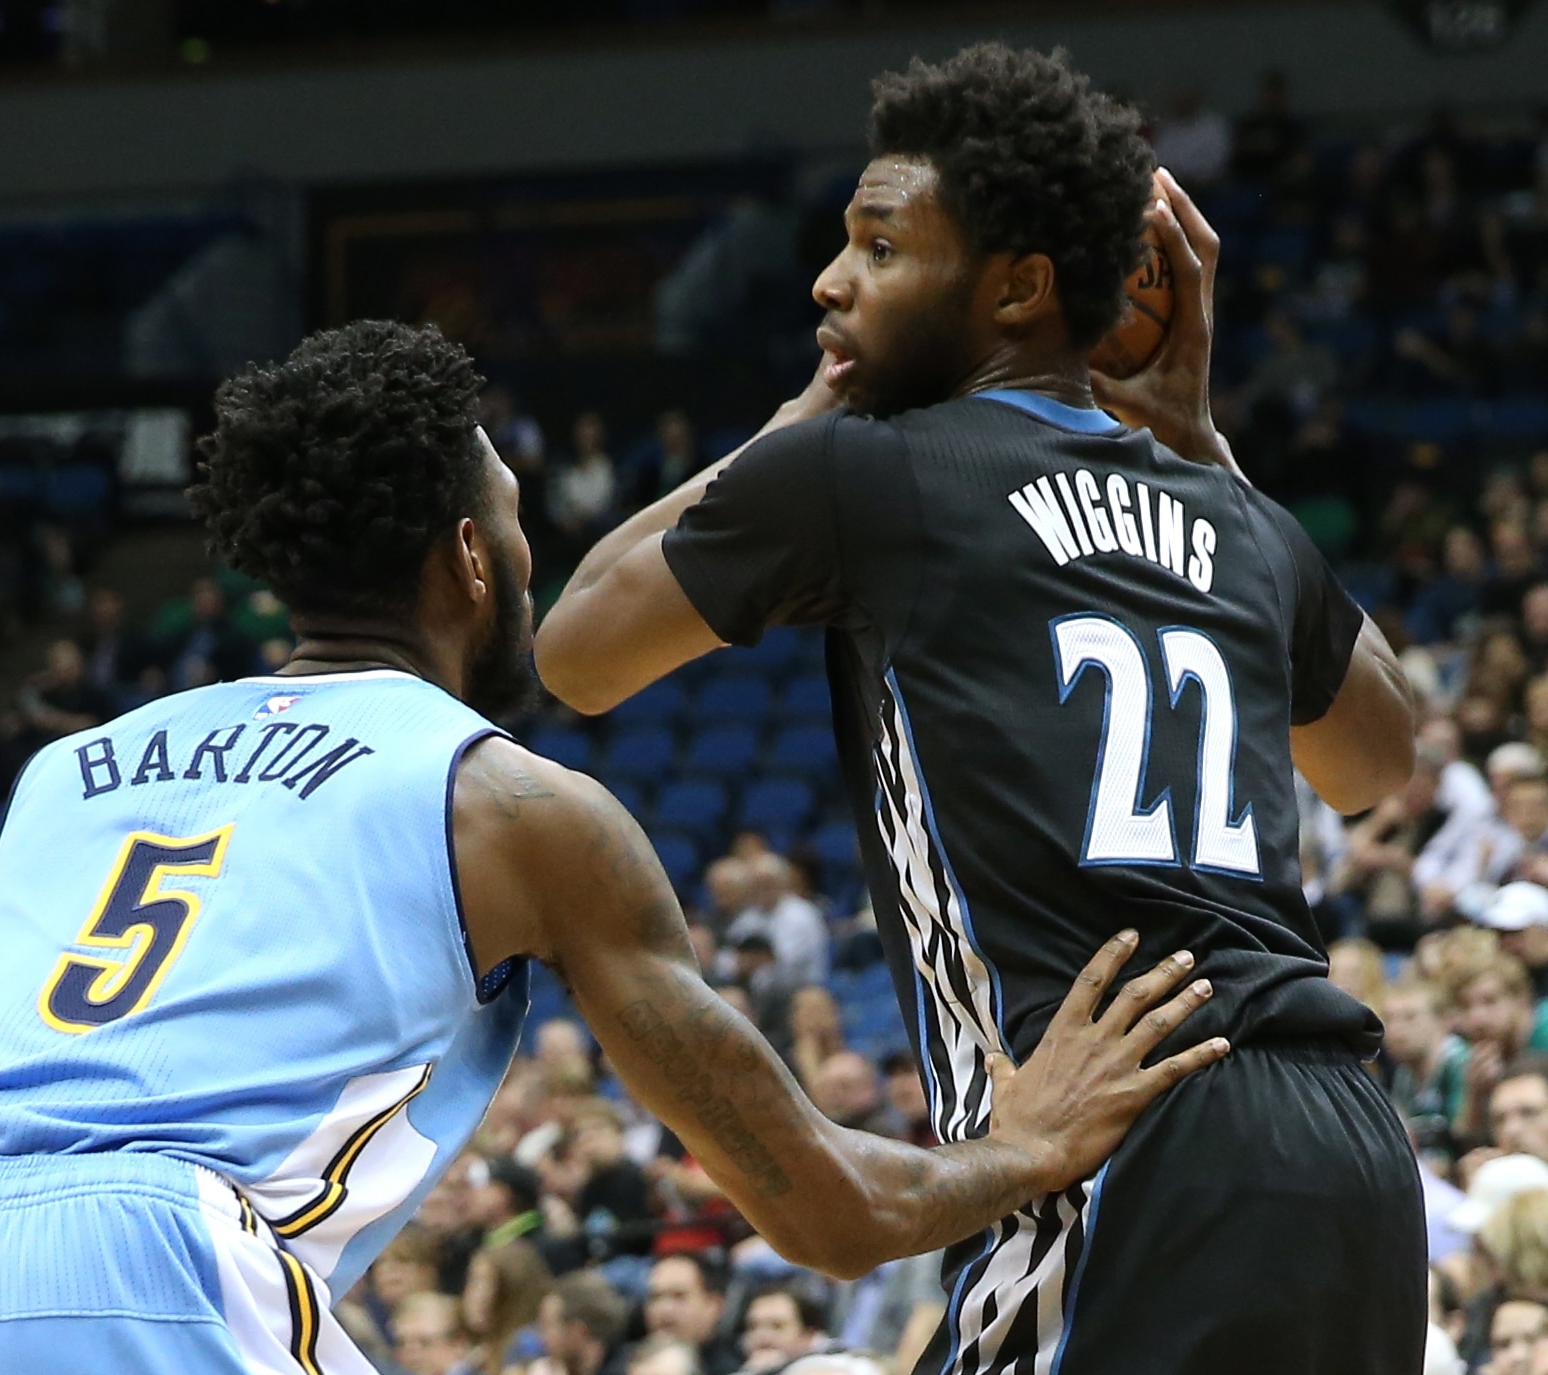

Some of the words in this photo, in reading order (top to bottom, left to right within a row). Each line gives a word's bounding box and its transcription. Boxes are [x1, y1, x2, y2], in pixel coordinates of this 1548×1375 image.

[1008, 469, 1217, 594] WIGGINS
[74, 721, 376, 801] BARTON
[1049, 611, 1264, 882] 22
[37, 822, 237, 1036] 5
